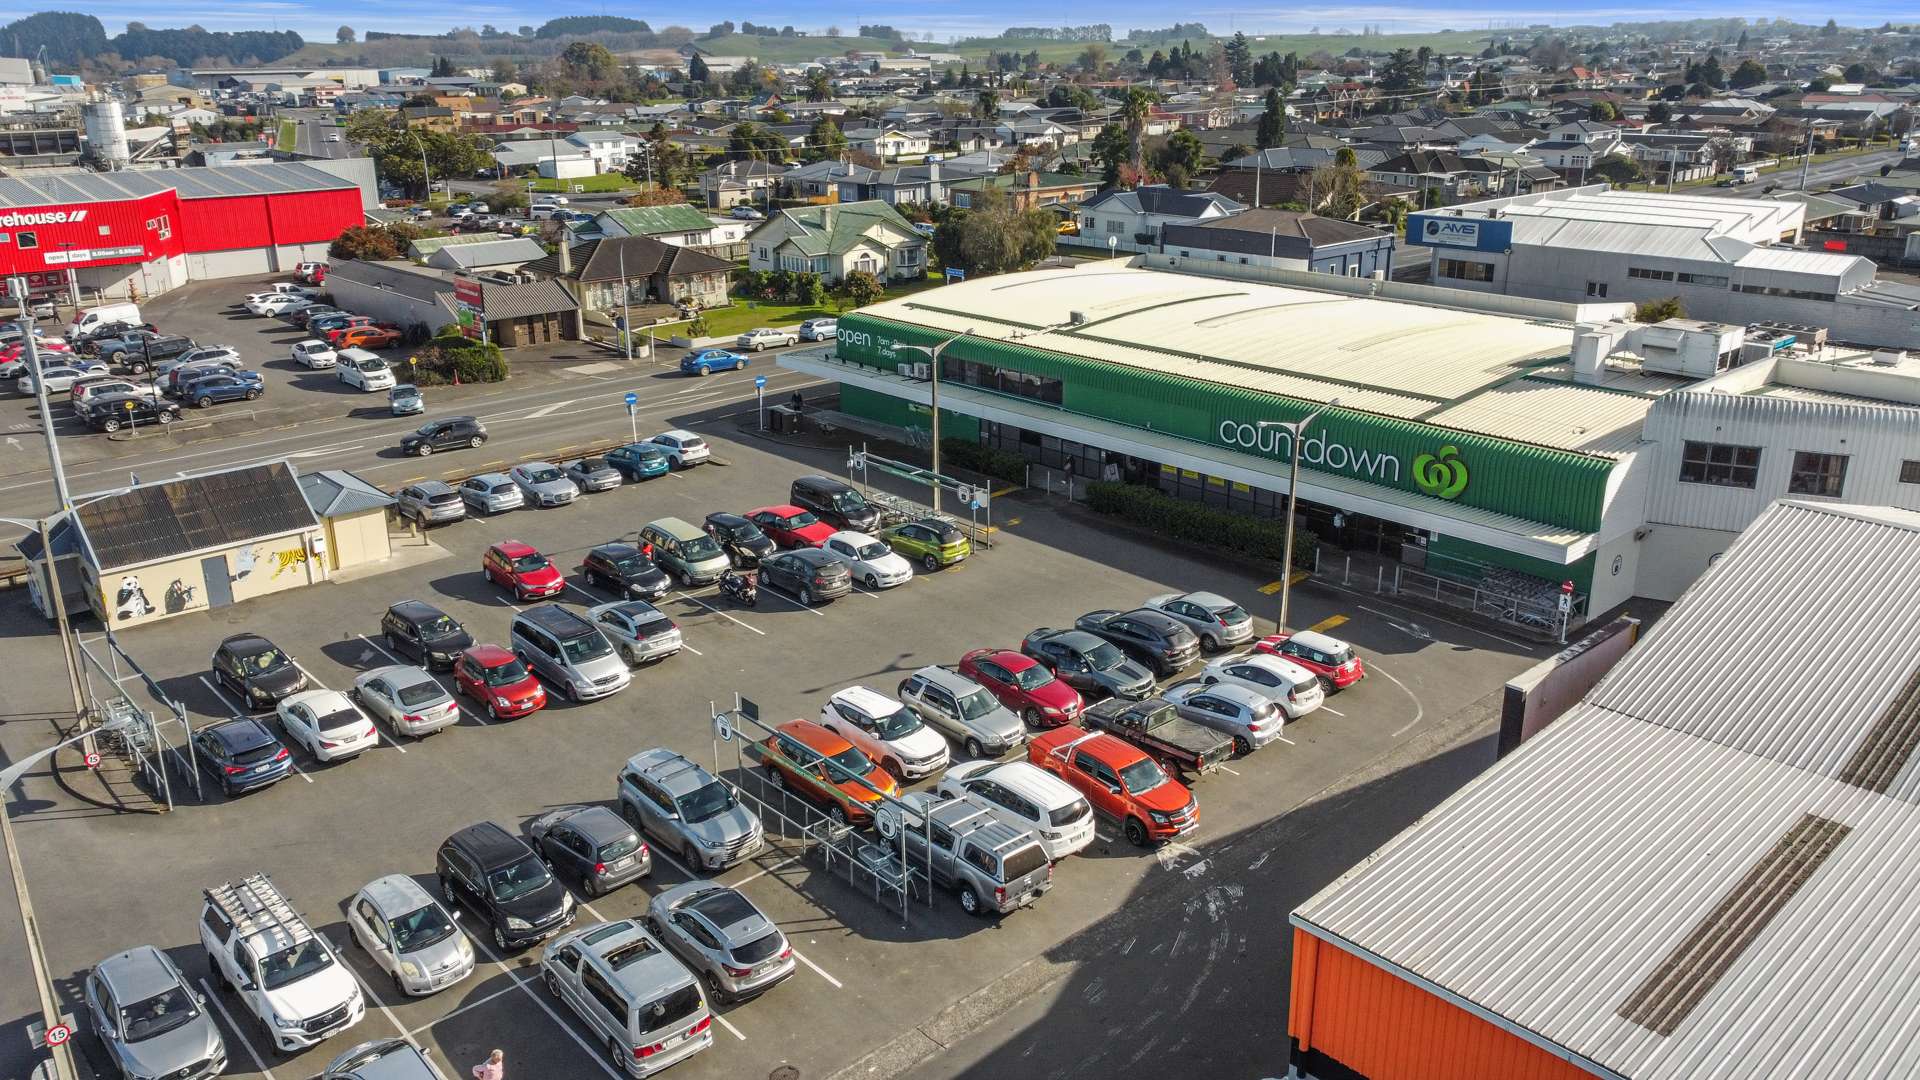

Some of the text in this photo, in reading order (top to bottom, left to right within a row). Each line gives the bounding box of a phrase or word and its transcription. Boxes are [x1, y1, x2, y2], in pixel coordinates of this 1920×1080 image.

[1441, 223, 1476, 235] AMS
[837, 328, 871, 347] open
[881, 347, 897, 359] days
[51, 1029, 65, 1041] 15
